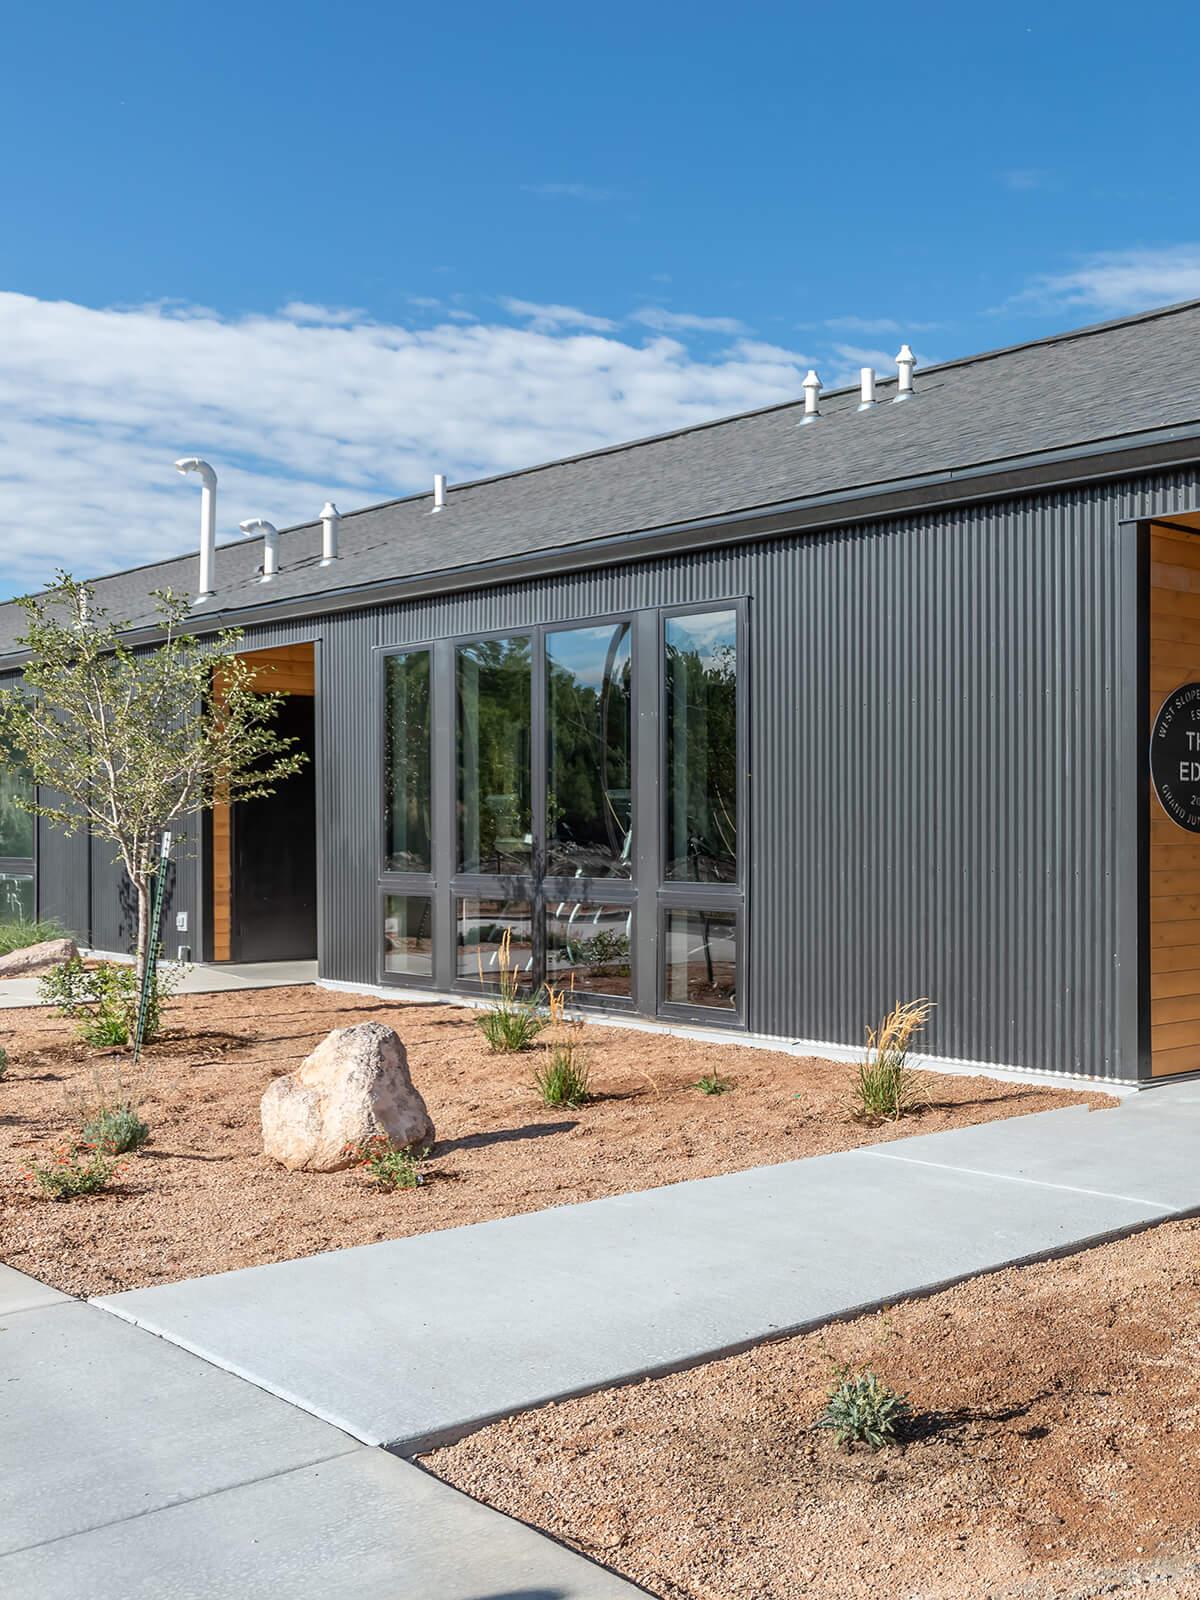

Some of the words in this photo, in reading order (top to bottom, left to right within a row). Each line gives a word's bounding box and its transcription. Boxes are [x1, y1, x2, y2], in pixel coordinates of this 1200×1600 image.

[1159, 706, 1176, 738] WEST
[1175, 689, 1200, 709] SLOPE
[1163, 784, 1186, 819] GRAND
